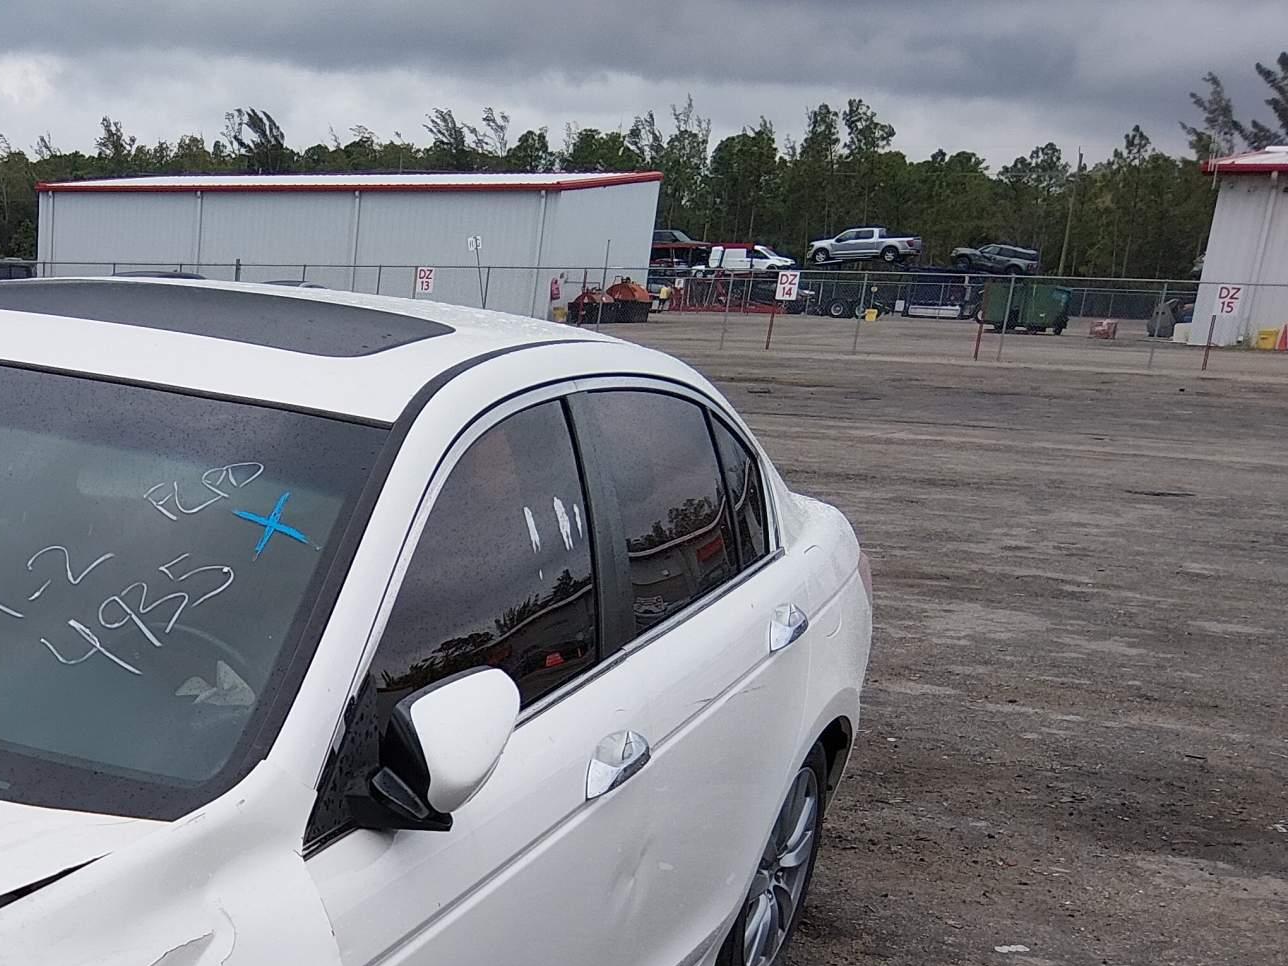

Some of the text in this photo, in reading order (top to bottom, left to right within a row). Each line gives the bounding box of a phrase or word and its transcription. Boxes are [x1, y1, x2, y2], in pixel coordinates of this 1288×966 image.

[418, 269, 433, 280] DZ
[779, 273, 798, 286] DZ
[420, 280, 430, 291] 13
[782, 286, 793, 298] 14
[1218, 286, 1241, 300] DZ
[1220, 301, 1234, 314] 15
[40, 553, 234, 675] 4935
